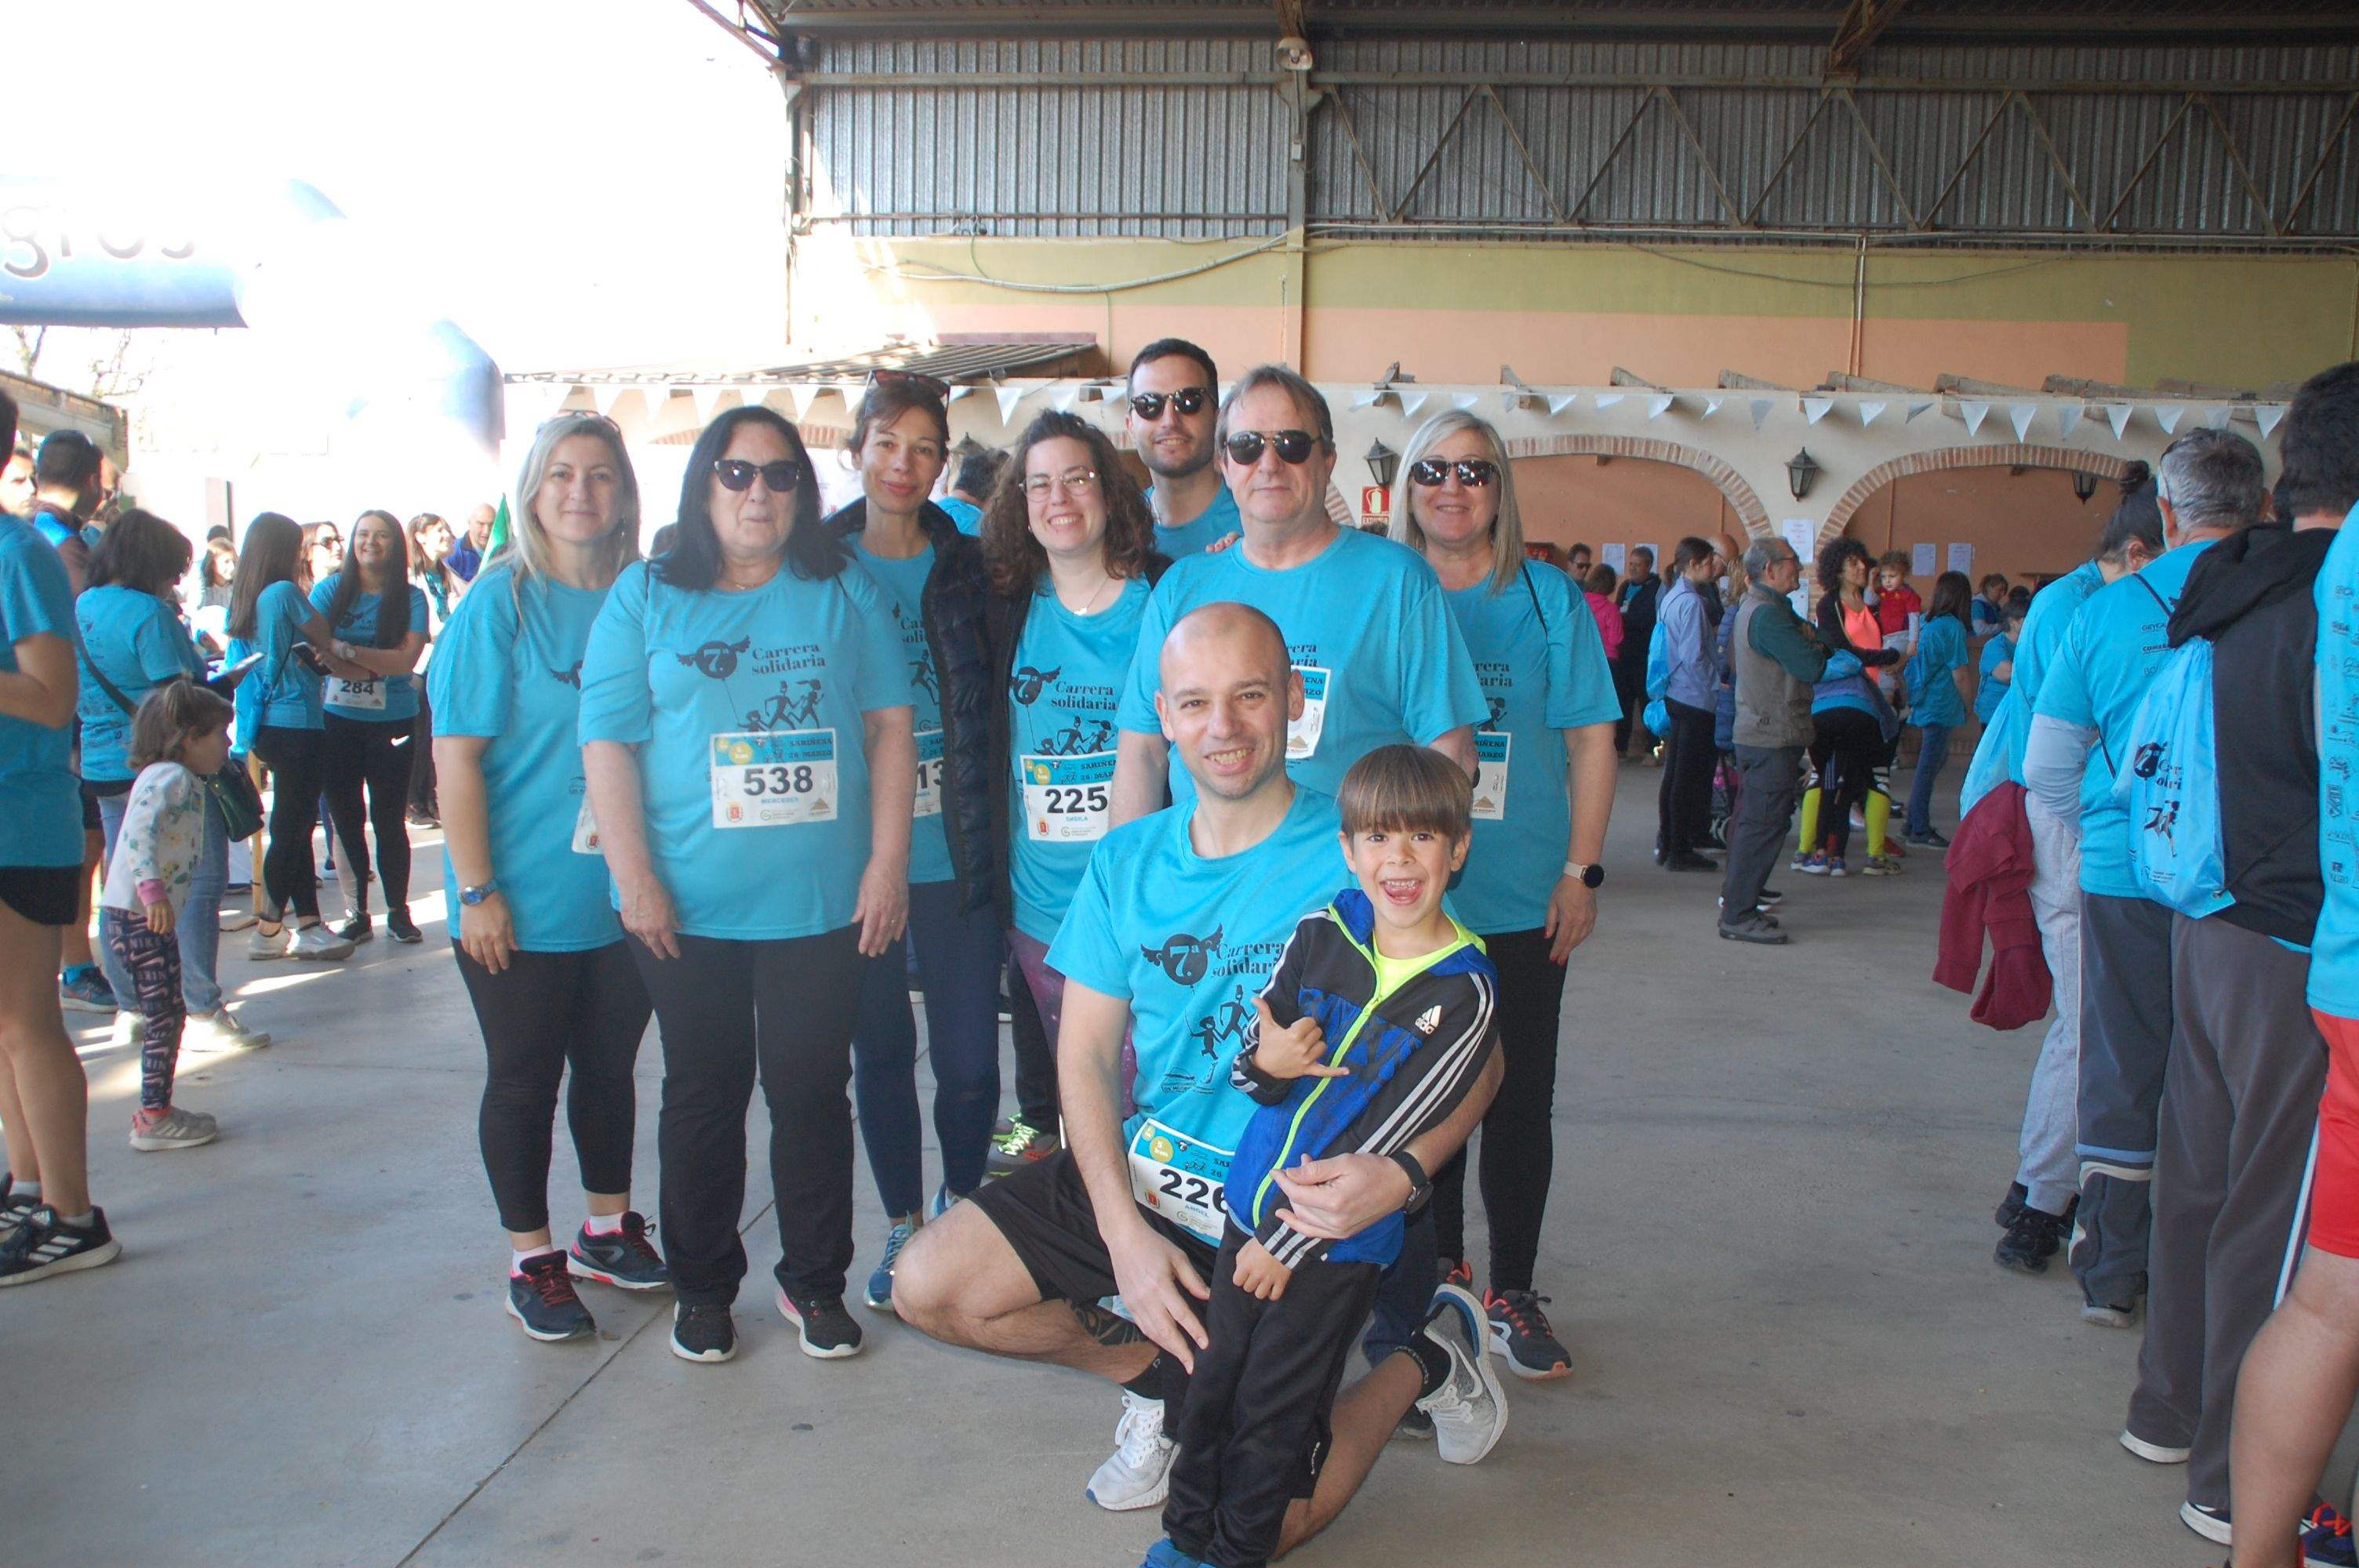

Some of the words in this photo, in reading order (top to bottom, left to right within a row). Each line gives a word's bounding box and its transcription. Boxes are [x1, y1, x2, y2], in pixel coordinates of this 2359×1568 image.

[752, 644, 820, 660] Carrera
[752, 654, 826, 675] solidaria
[1474, 662, 1510, 673] rera
[340, 680, 374, 695] 284
[1056, 681, 1114, 695] Carrera
[1051, 695, 1118, 711] solidaria
[743, 765, 813, 797] 538
[1045, 786, 1108, 814] 225
[1212, 956, 1280, 978] solidari
